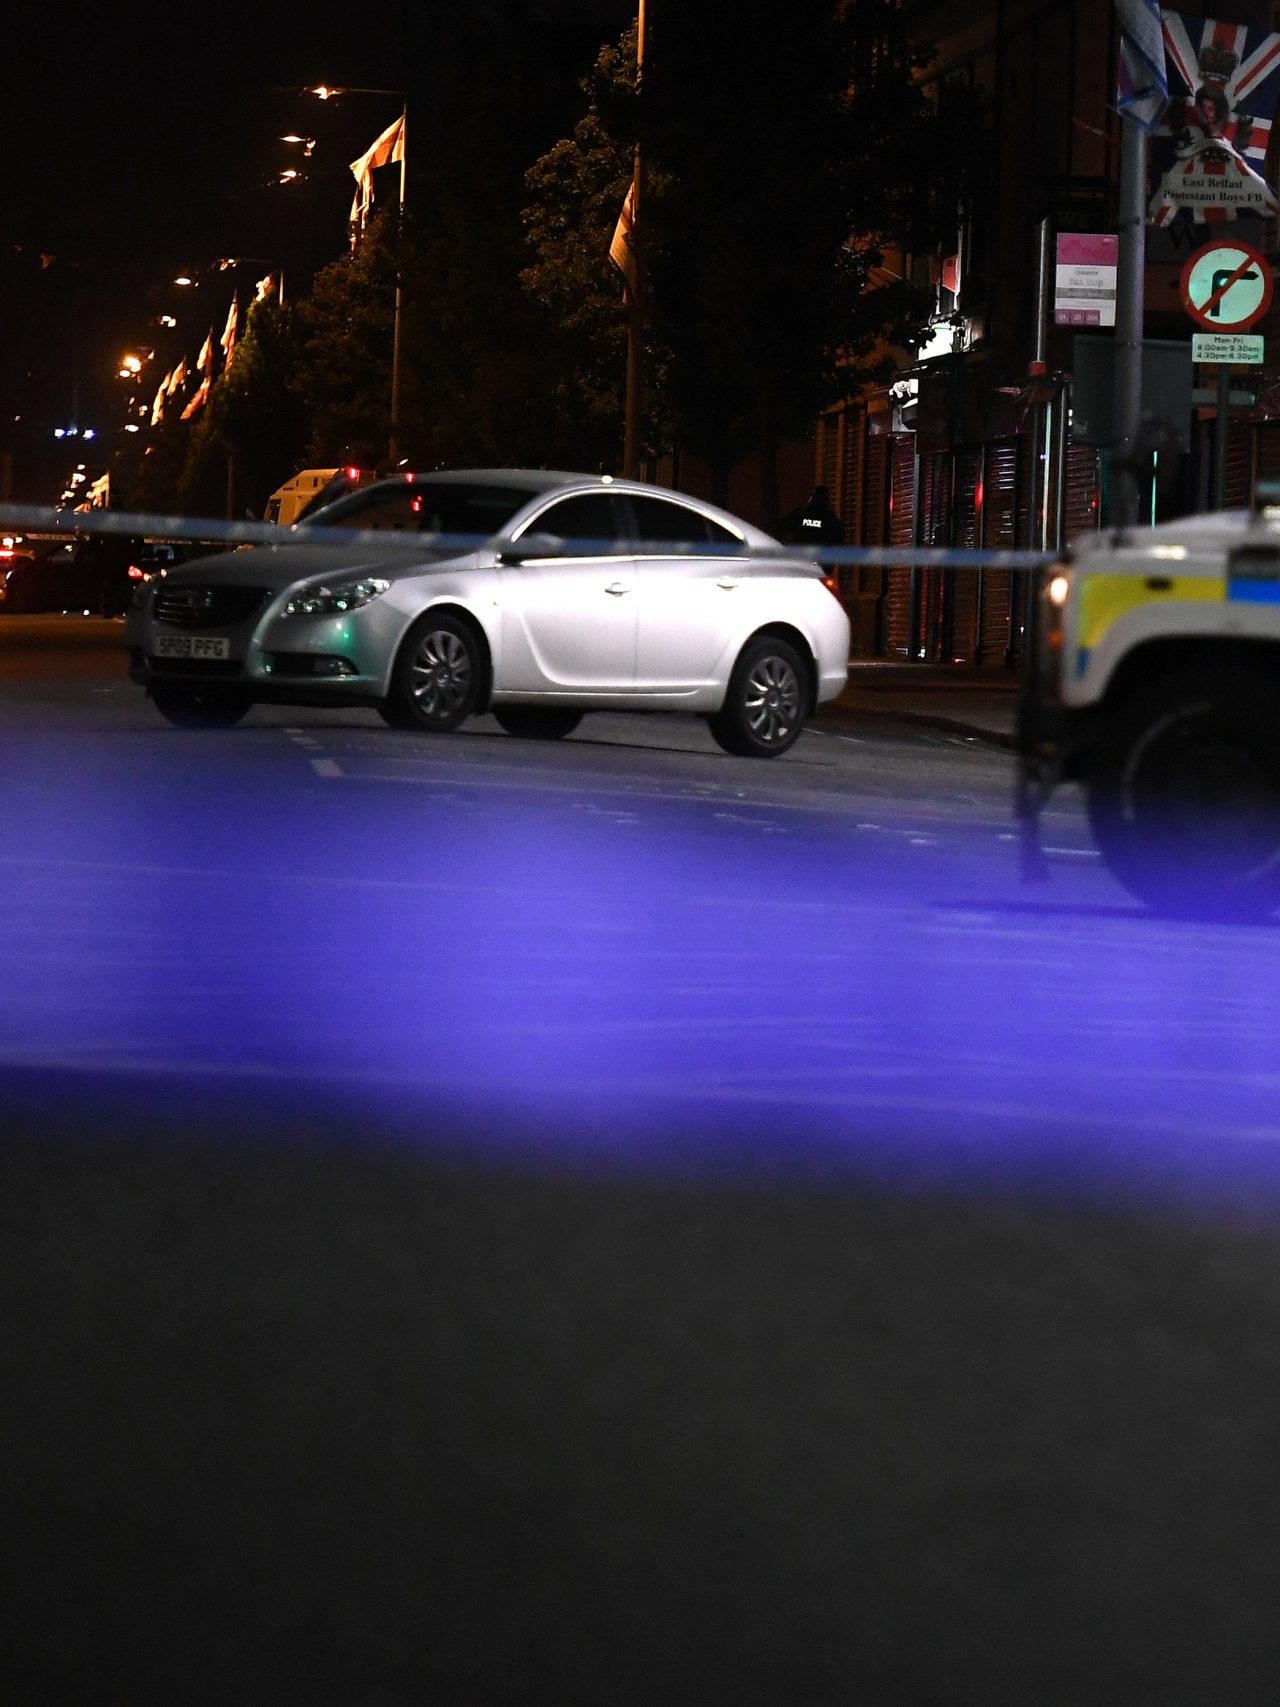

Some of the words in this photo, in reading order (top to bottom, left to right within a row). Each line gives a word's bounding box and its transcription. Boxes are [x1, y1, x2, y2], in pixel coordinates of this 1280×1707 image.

[1182, 178, 1205, 189] East
[1208, 178, 1243, 189] Belfast
[1163, 189, 1217, 202] Protestant
[1219, 191, 1244, 203] Boys
[1247, 192, 1263, 203] FB
[802, 518, 822, 528] POLICE
